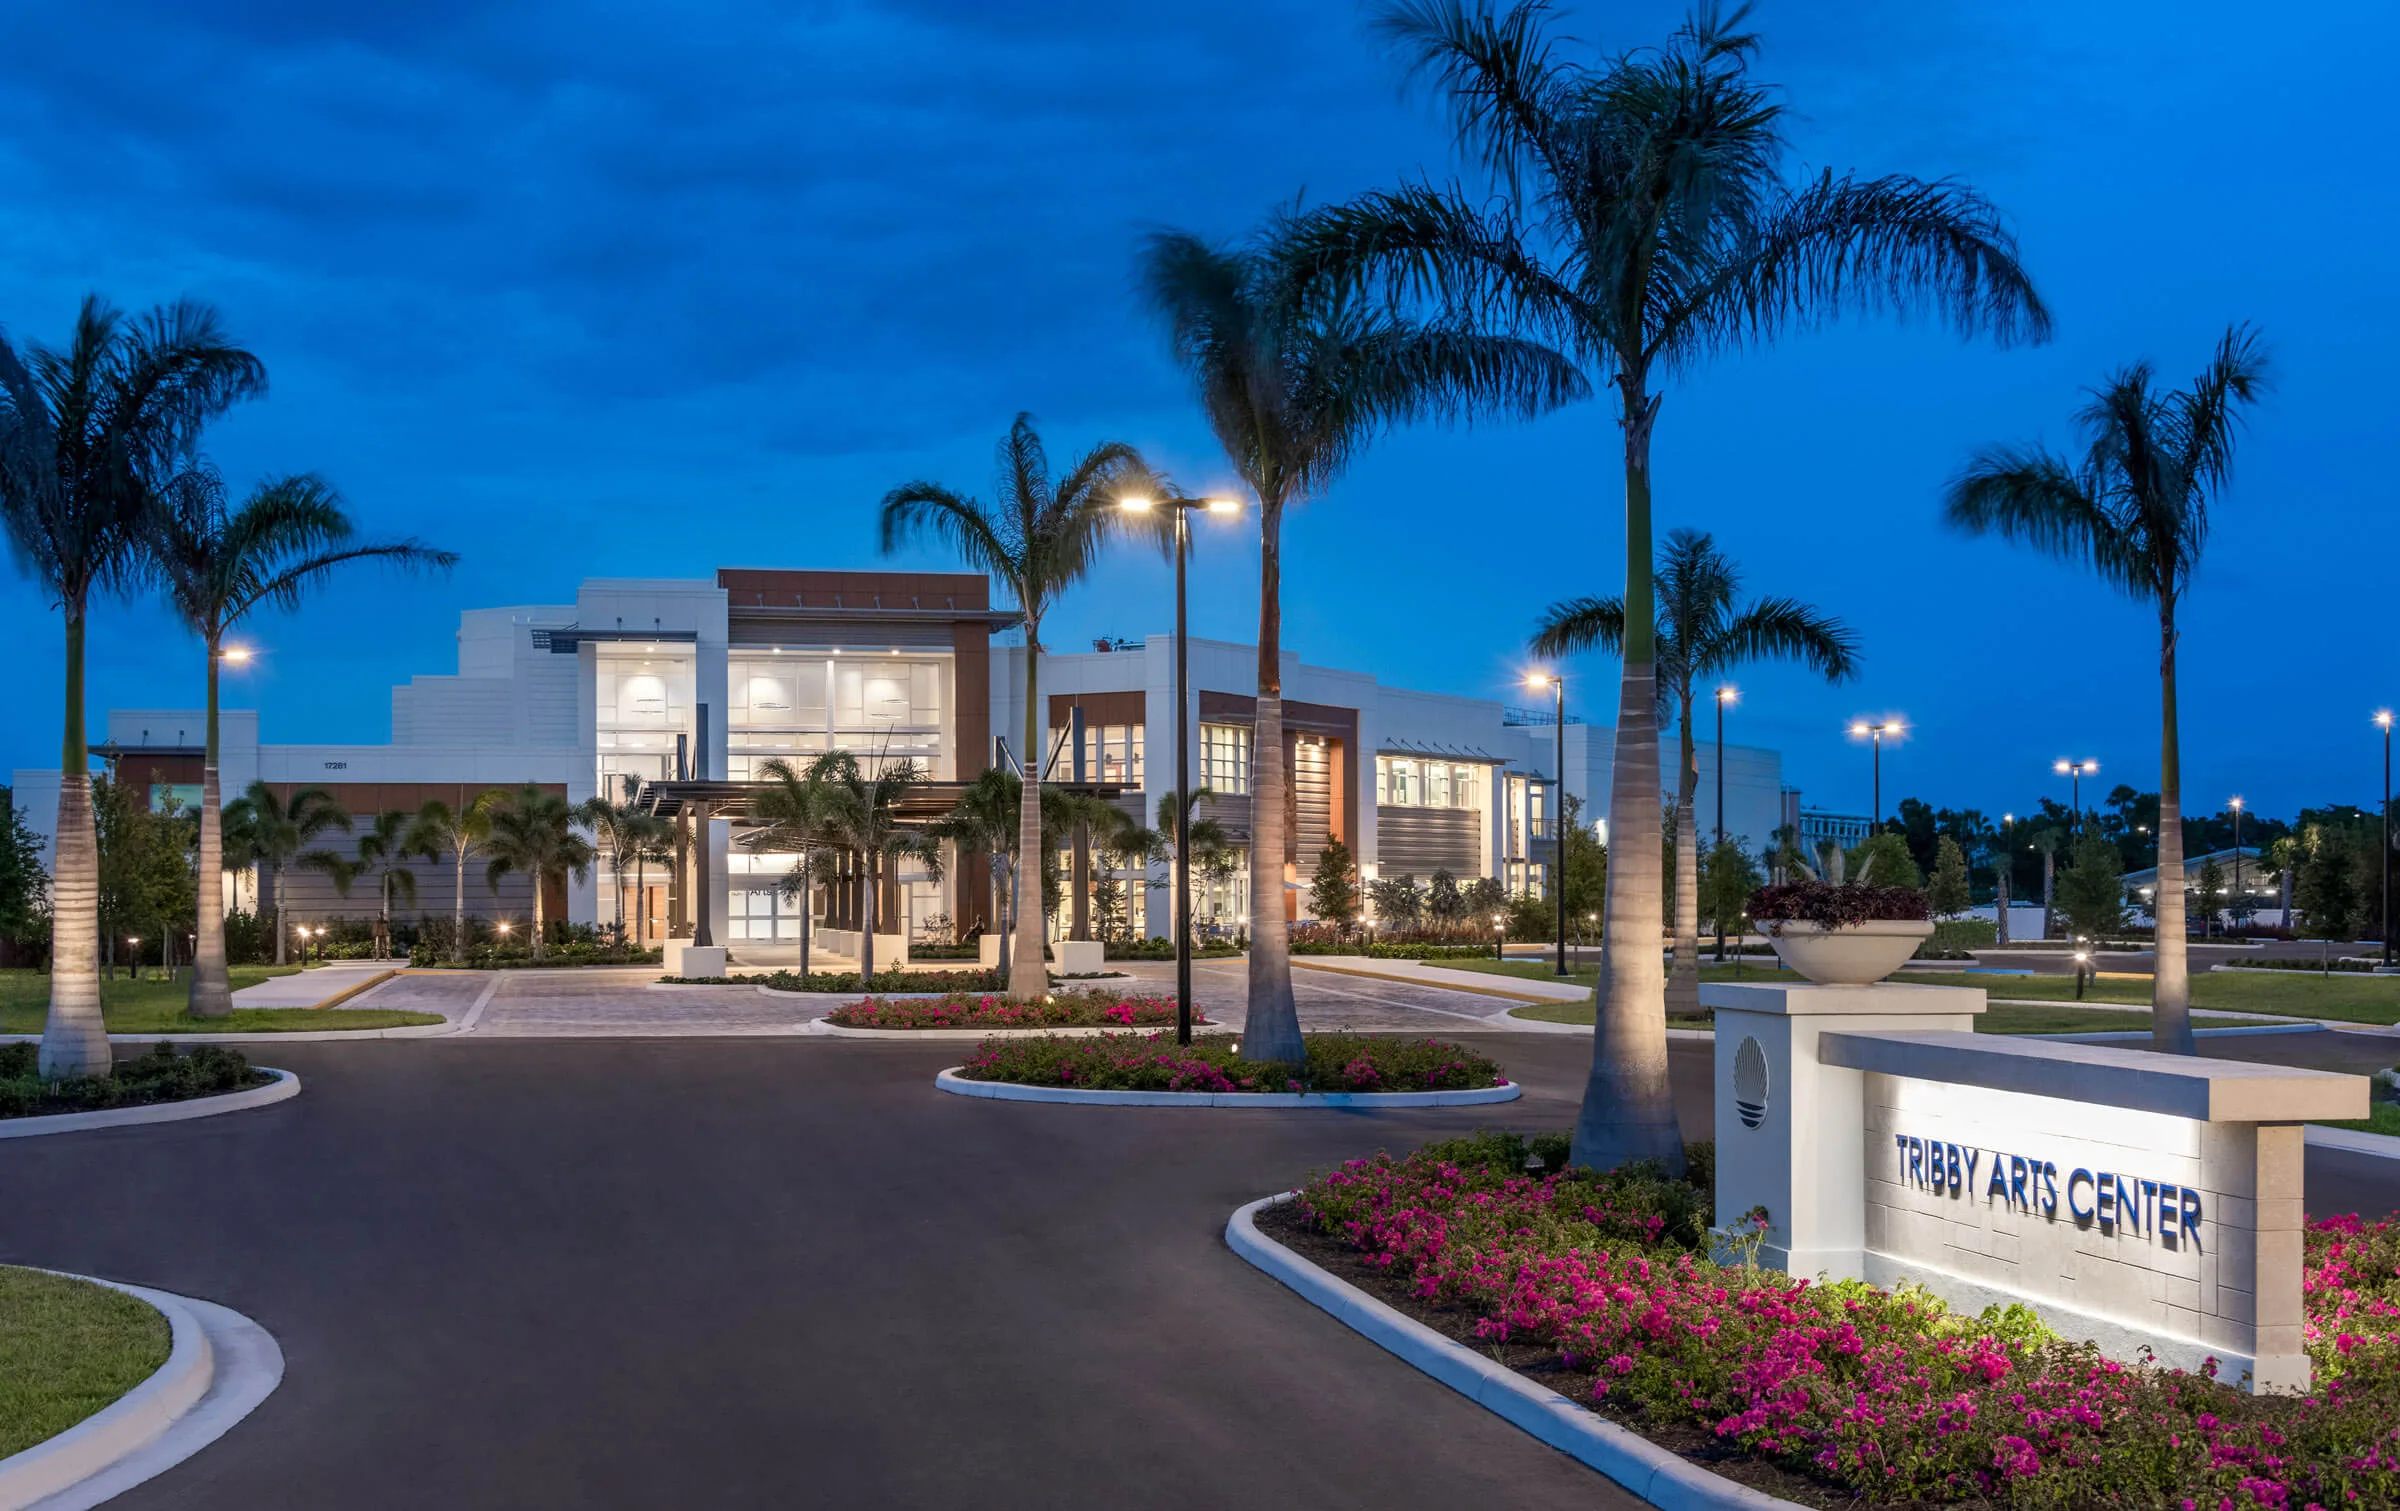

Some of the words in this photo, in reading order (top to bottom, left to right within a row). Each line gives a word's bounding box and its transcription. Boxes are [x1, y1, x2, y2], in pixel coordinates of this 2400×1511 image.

[1895, 1133, 1979, 1194] TRIBBY
[1987, 1151, 2057, 1211] ARTS
[2067, 1167, 2202, 1246] CENTER
